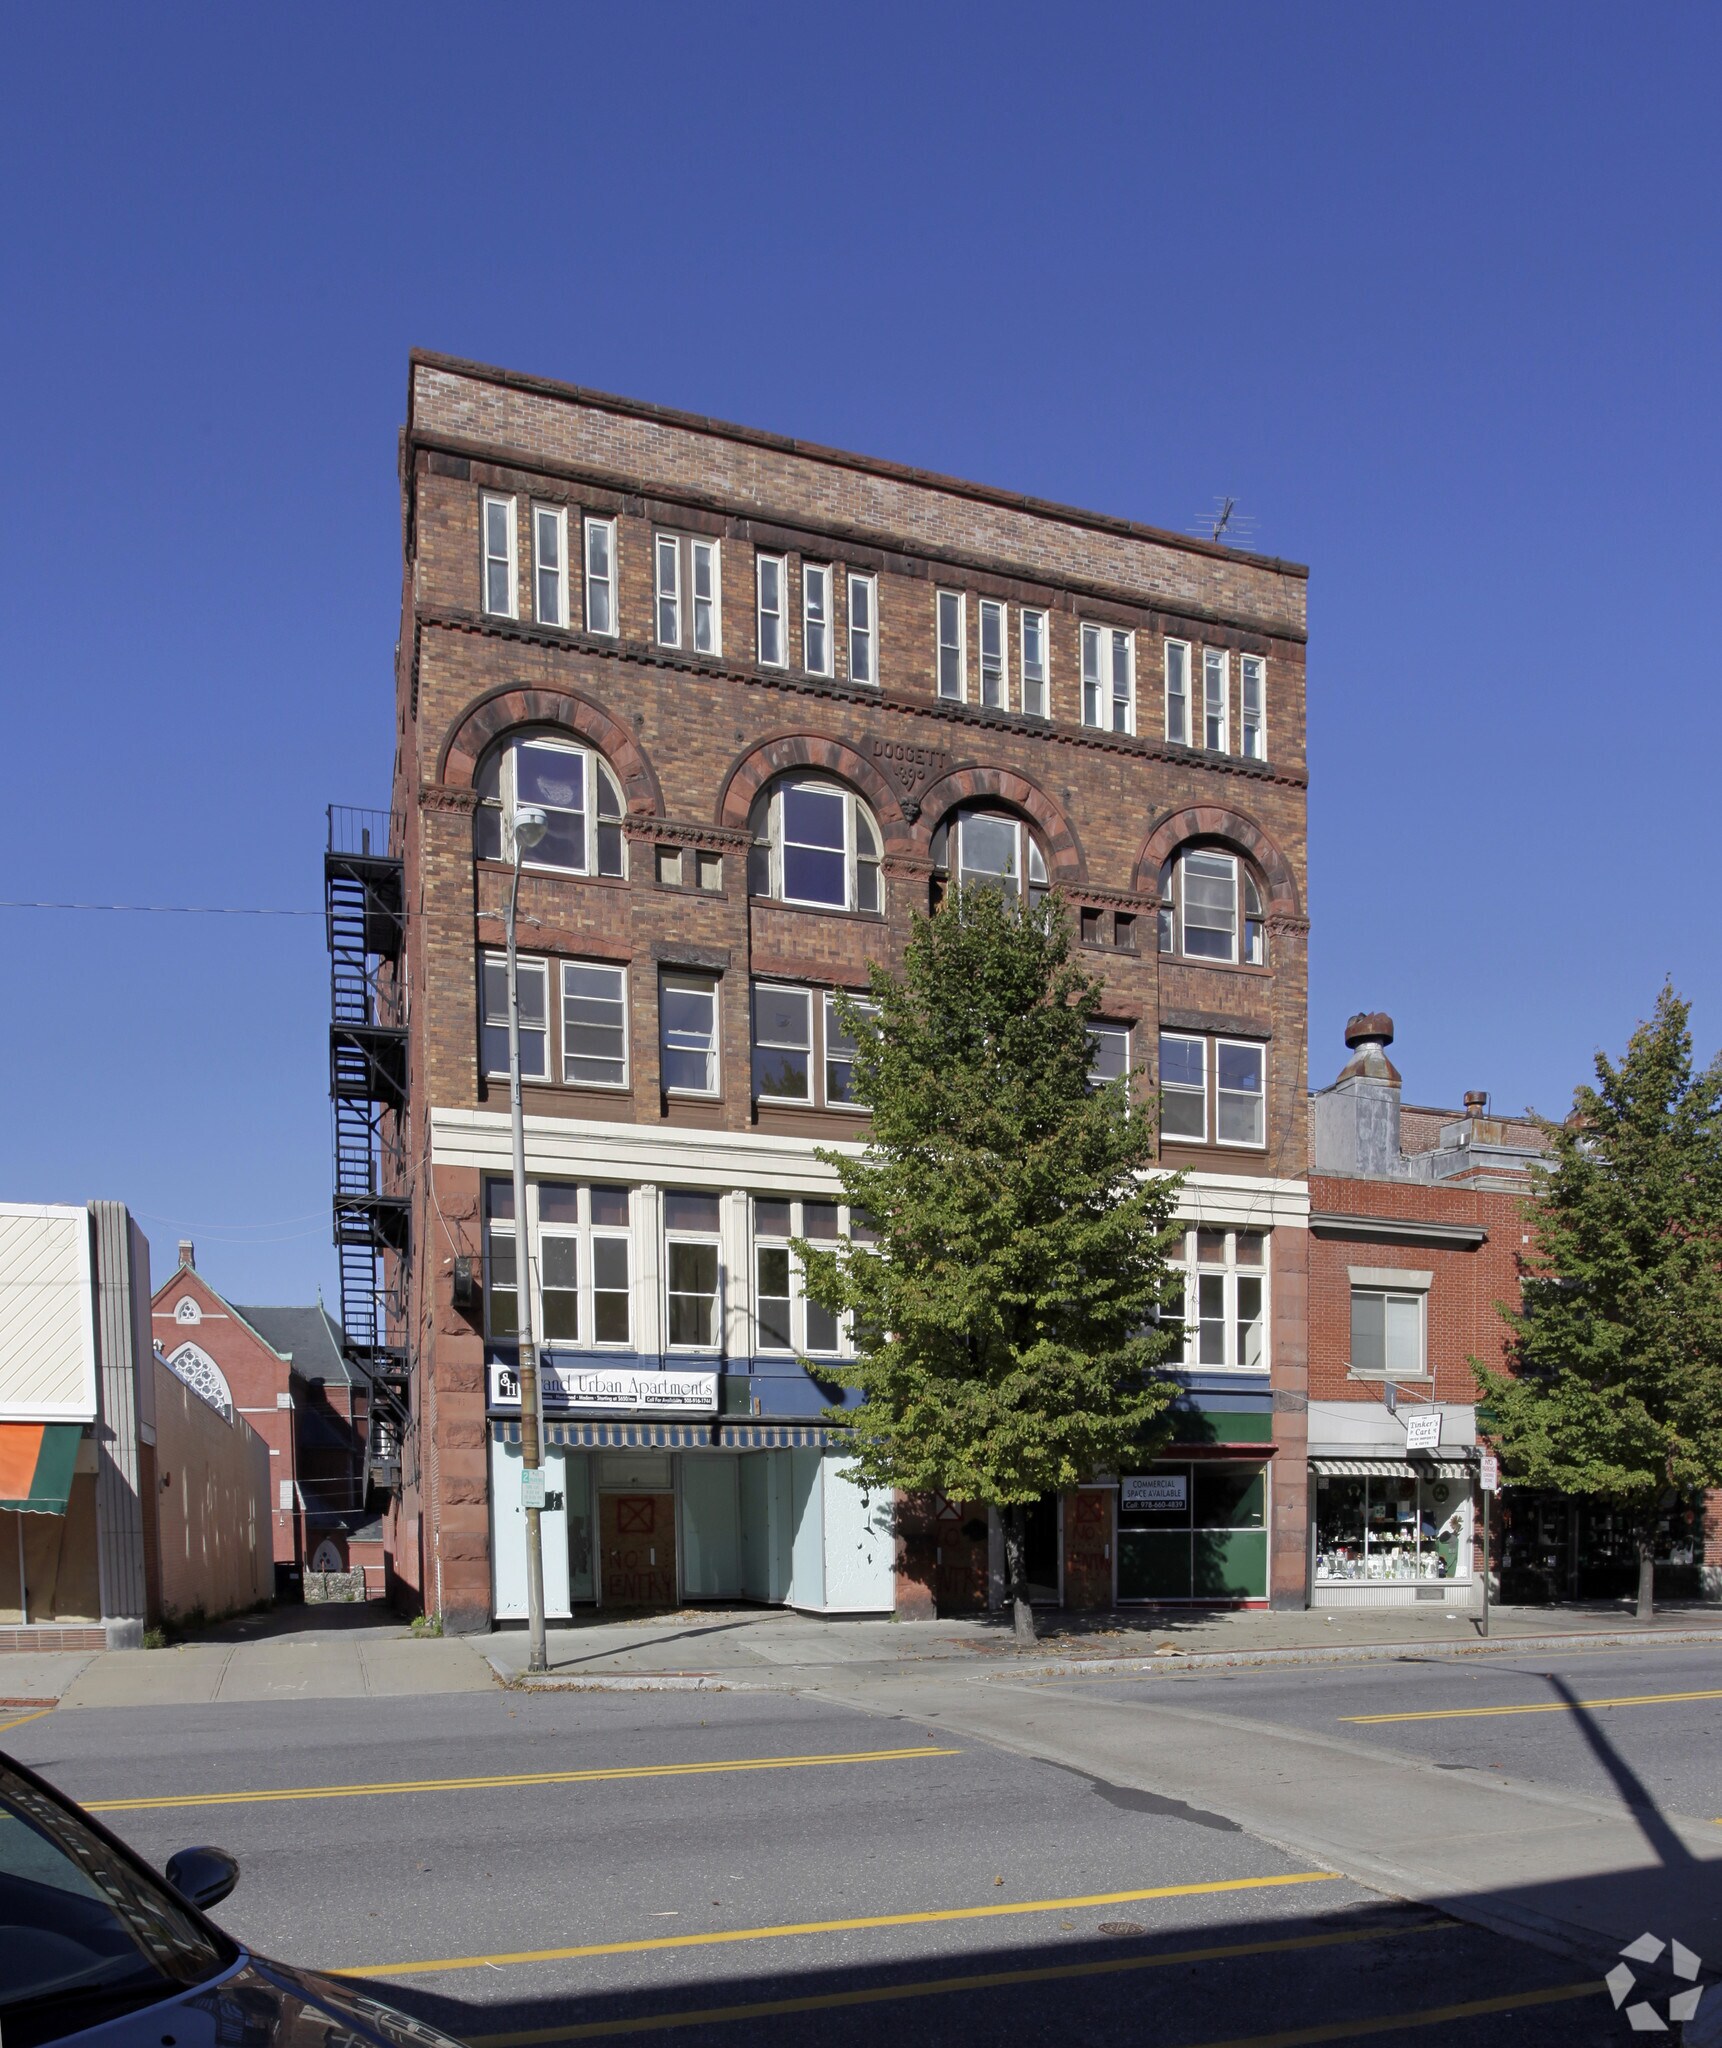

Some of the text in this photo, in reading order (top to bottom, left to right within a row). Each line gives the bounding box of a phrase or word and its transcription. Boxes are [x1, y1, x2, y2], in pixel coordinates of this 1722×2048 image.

[873, 741, 946, 768] DOGGETT
[578, 1375, 622, 1393] Urban
[628, 1377, 713, 1400] Apartments
[1410, 1420, 1439, 1429] Tinker's
[1415, 1428, 1431, 1436] Cart
[522, 1472, 528, 1482] 2
[1132, 1480, 1175, 1488] COMMERCIAL
[1127, 1489, 1181, 1498] SPACE AVAILABLE
[608, 1547, 638, 1569] NO
[608, 1570, 671, 1602] ENTRY
